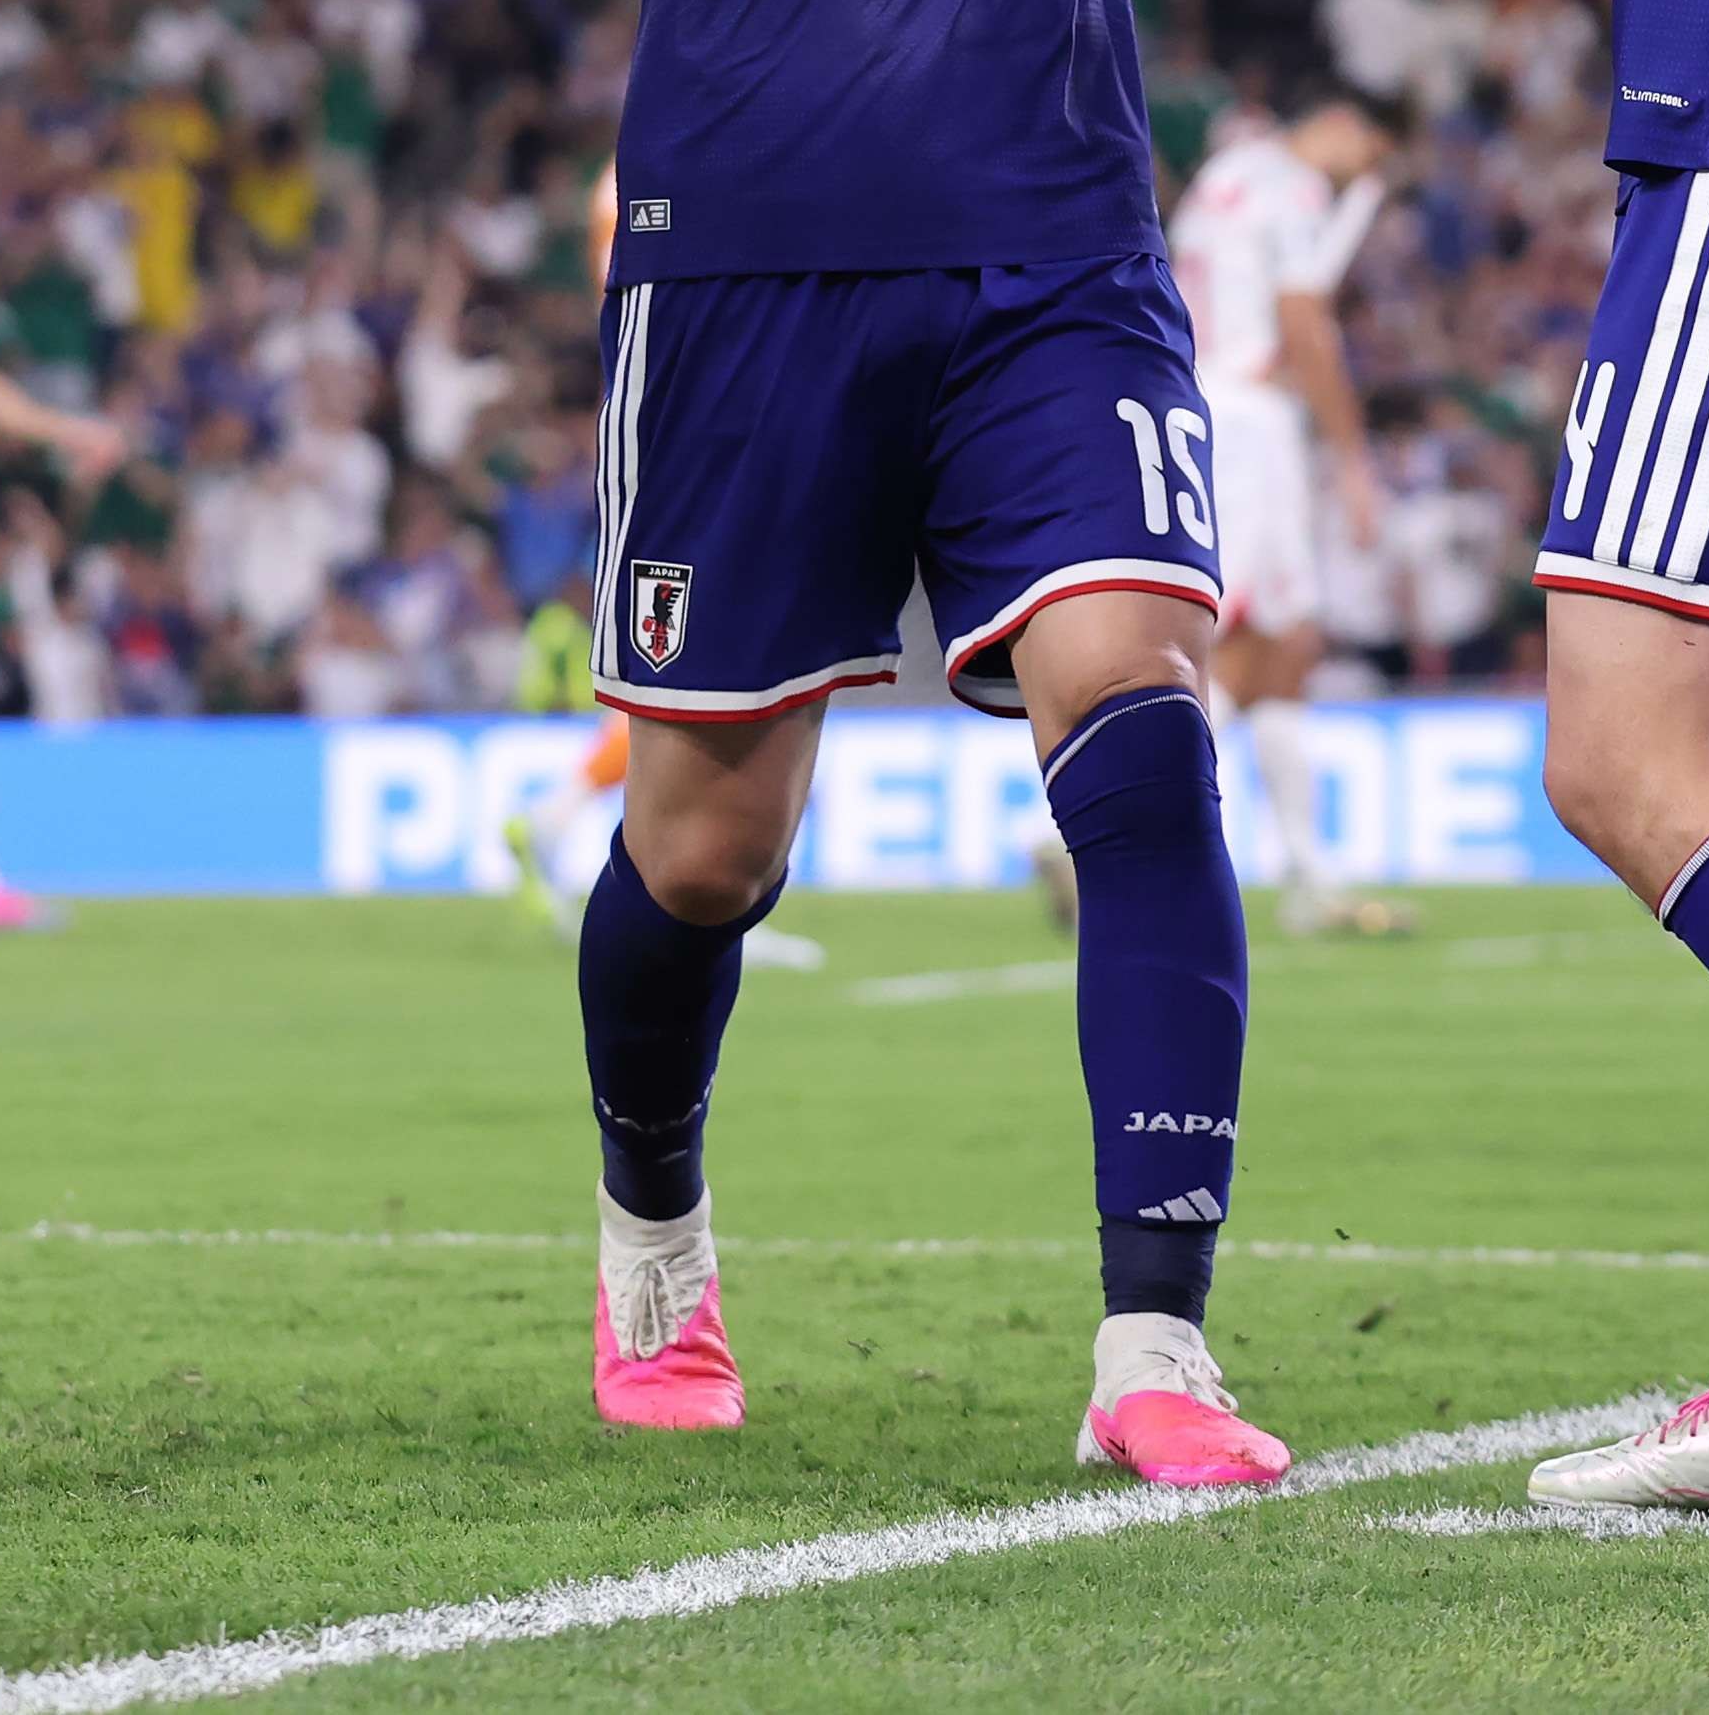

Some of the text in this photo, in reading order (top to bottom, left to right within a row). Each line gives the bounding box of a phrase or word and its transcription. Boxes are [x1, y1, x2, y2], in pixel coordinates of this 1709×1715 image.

[1116, 397, 1214, 550] 15
[648, 567, 681, 579] JAPAN
[1123, 1111, 1239, 1141] JAPA
